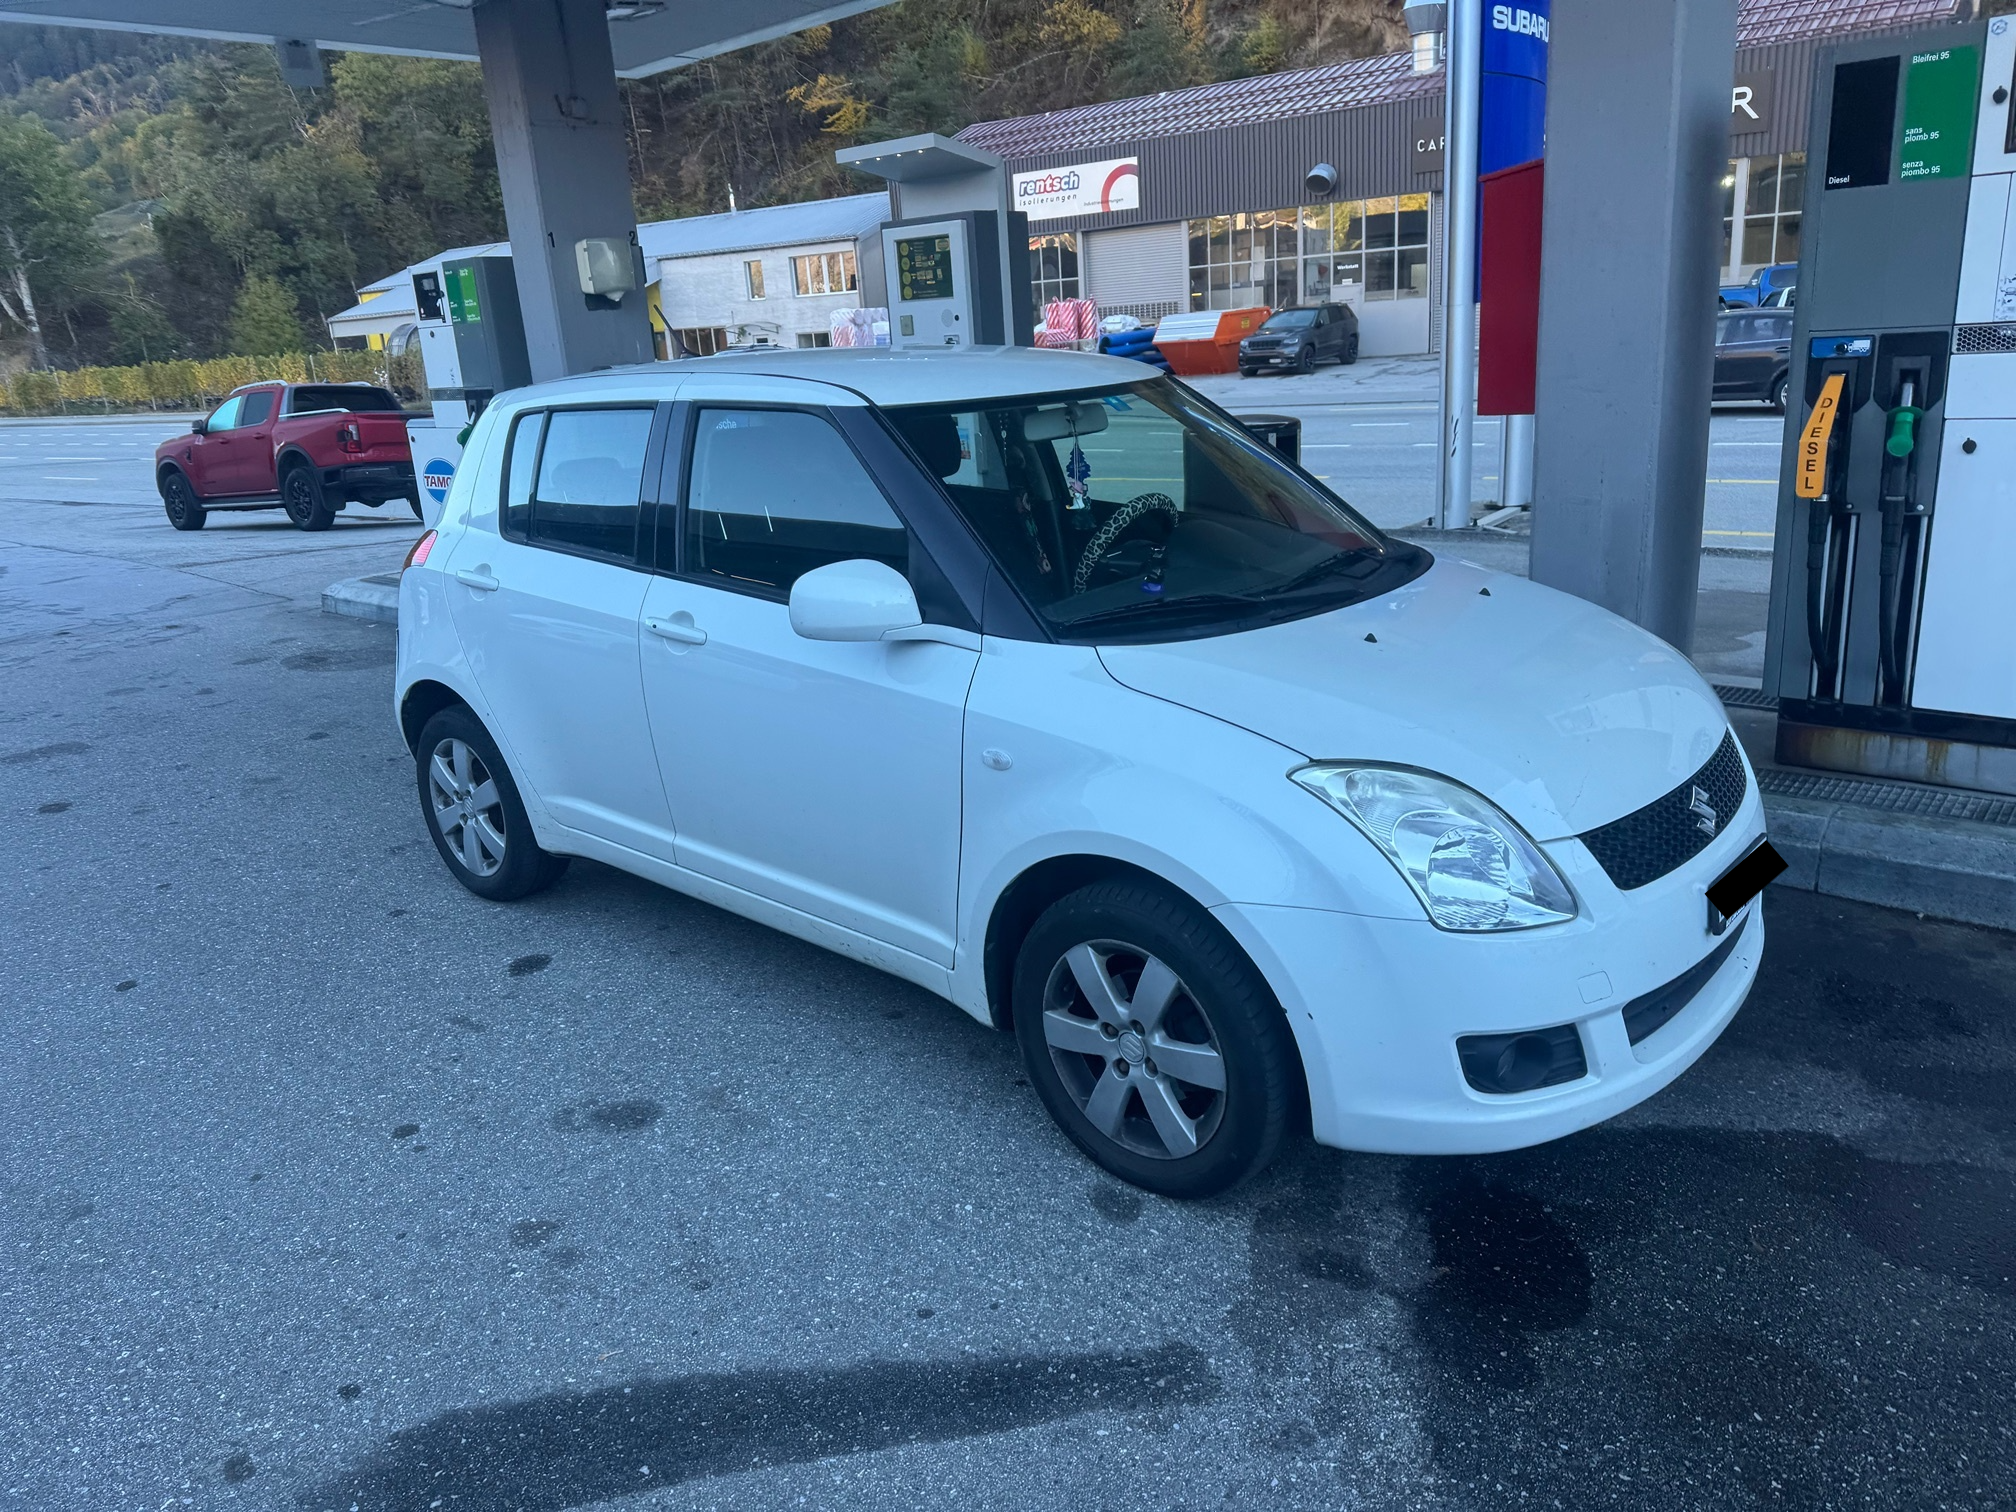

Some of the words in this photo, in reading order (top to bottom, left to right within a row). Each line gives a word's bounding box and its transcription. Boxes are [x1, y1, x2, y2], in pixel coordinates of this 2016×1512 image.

[1492, 4, 1550, 43] SUBARU
[1912, 52, 1939, 64] Bleifrei
[1940, 51, 1950, 60] 95
[1904, 132, 1929, 144] plomb
[1929, 131, 1940, 140] 95
[1905, 127, 1923, 135] sans
[1902, 160, 1924, 169] senza
[1901, 166, 1930, 178] piombo
[1931, 165, 1941, 174] 95
[1019, 171, 1080, 197] rentsch
[1828, 175, 1850, 185] Diesel
[1019, 193, 1077, 206] isolierungen
[547, 231, 556, 248] 1
[628, 230, 637, 247] 2
[1804, 397, 1834, 490] DIESEL
